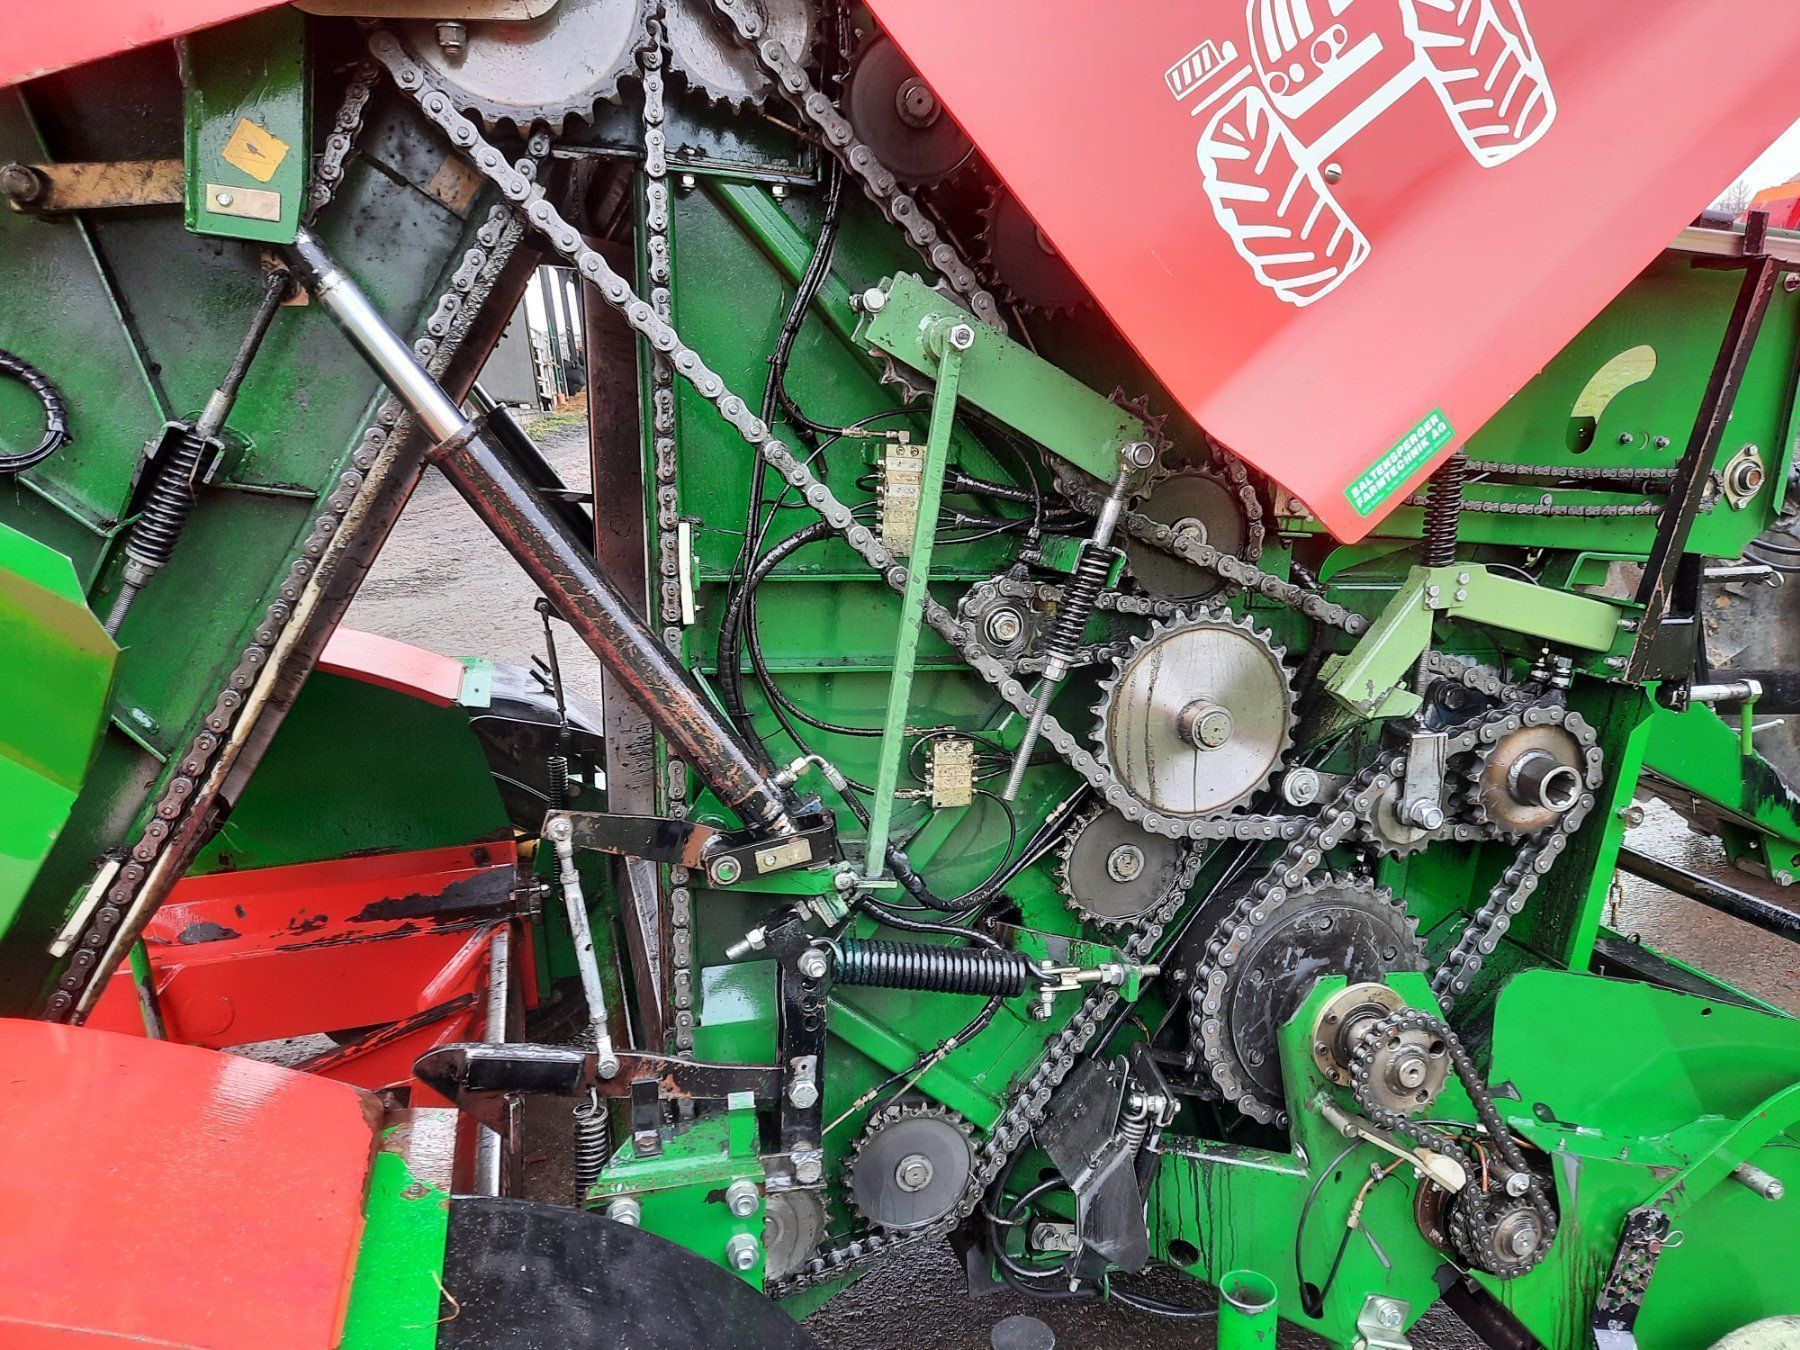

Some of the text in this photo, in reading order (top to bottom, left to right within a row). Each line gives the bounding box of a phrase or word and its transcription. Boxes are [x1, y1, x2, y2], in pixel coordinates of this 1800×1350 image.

[1351, 414, 1439, 498] BALTENSPERGER
[1356, 437, 1429, 508] FARMTECHNIK
[1431, 422, 1447, 440] AG
